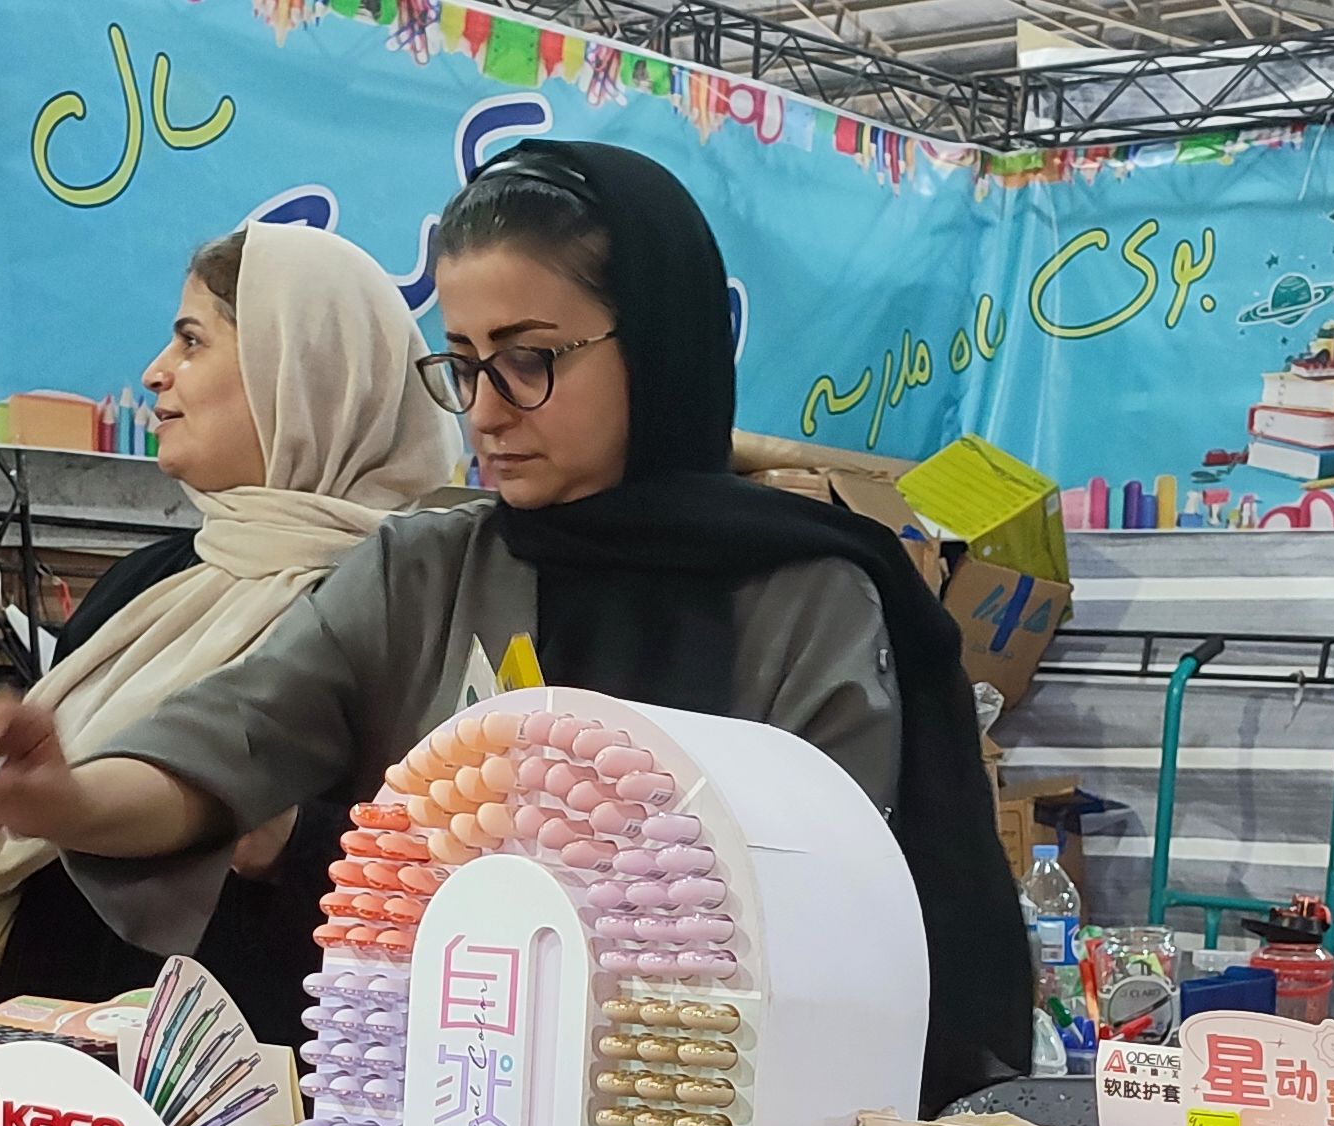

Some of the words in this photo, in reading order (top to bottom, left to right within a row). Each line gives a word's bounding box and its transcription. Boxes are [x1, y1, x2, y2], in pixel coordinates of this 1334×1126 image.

[31, 23, 235, 208] سال
[1028, 217, 1216, 342] بوی
[800, 328, 933, 450] مدرسه
[1103, 1077, 1181, 1105] 软胶护套
